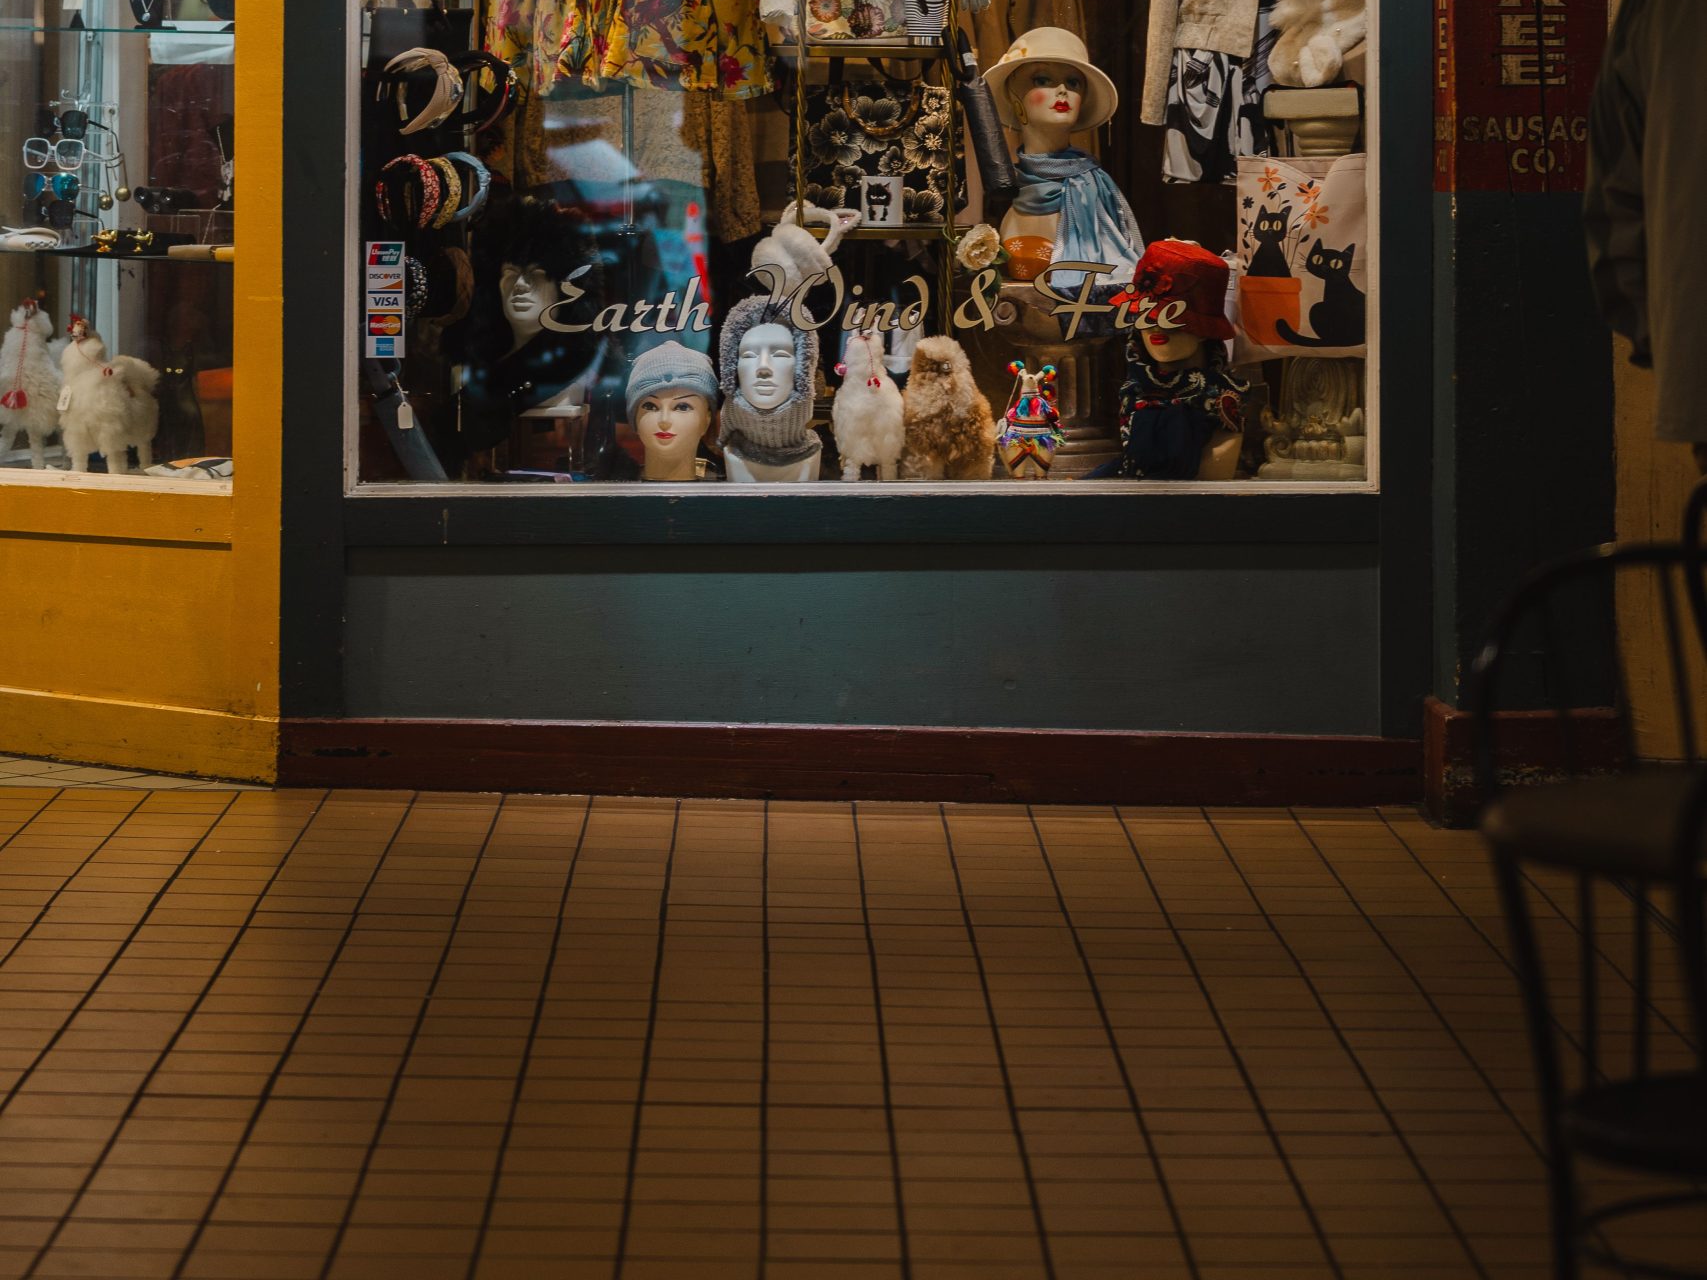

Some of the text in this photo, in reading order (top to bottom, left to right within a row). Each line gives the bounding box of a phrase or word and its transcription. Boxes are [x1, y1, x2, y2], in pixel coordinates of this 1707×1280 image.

[1462, 115, 1588, 143] SAUSAG
[1510, 147, 1565, 175] CO.
[372, 296, 399, 306] VISA
[538, 260, 1189, 341] Earth Wind & Fire
